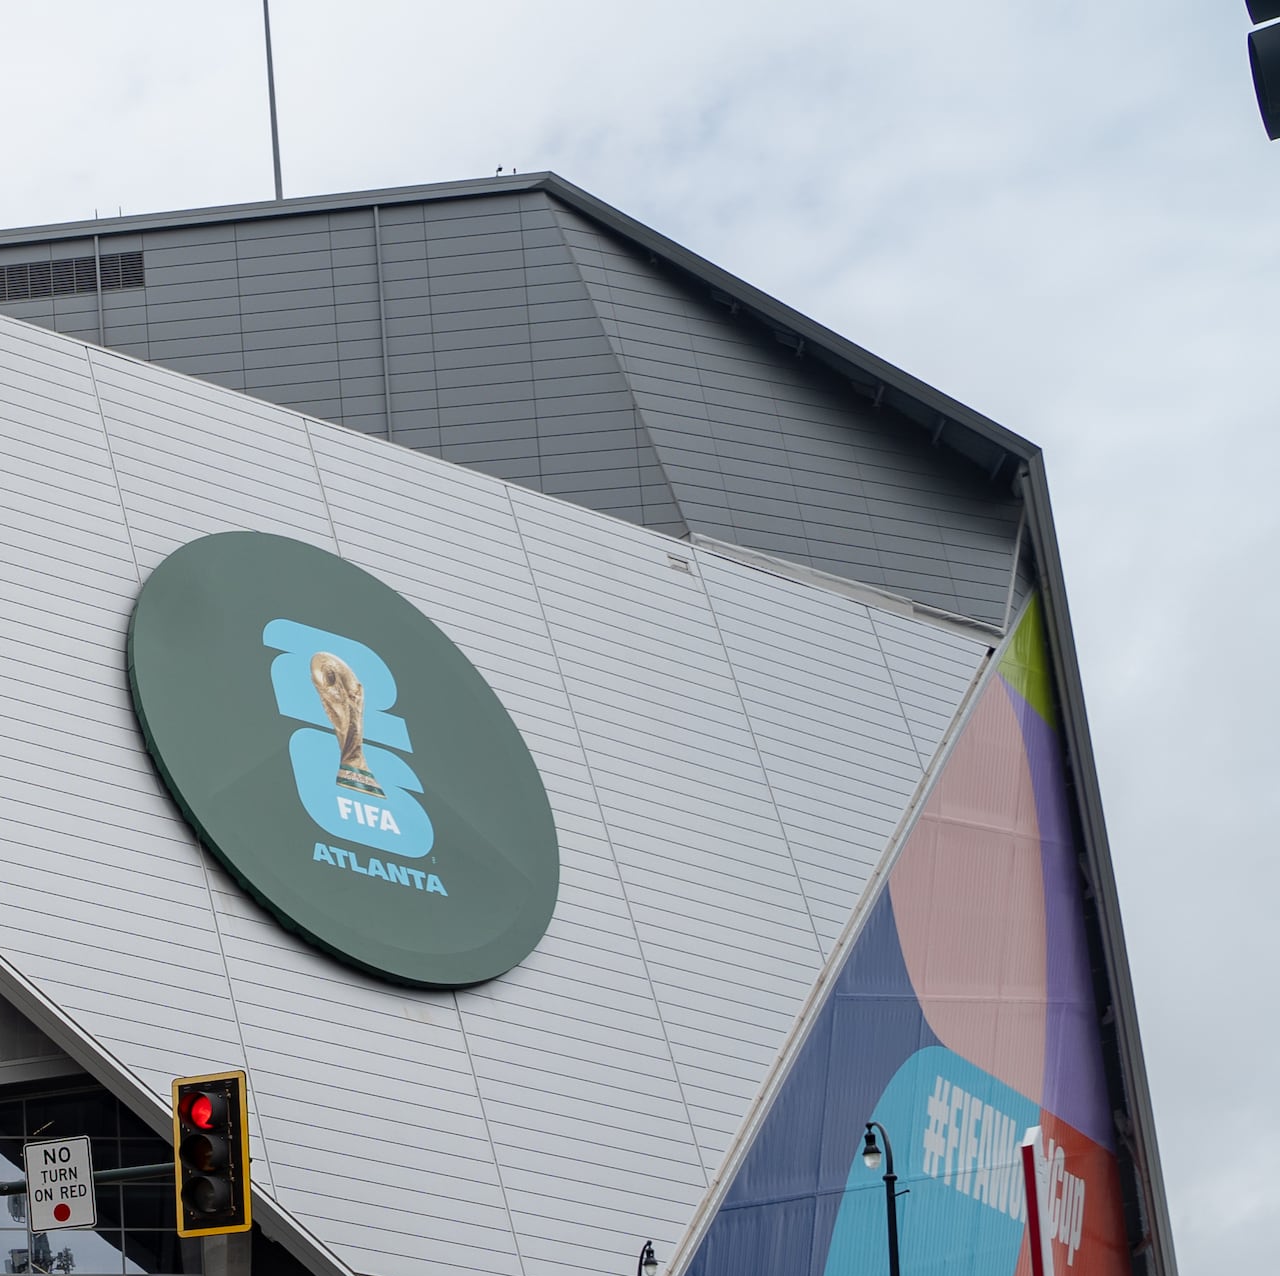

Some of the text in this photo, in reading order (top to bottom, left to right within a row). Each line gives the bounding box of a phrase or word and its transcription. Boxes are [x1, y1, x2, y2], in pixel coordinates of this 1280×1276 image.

[336, 796, 401, 836] FIFA
[312, 842, 449, 897] ATLANTA
[43, 1147, 71, 1165] NO
[40, 1166, 78, 1183] TURN
[34, 1184, 87, 1202] ON RED
